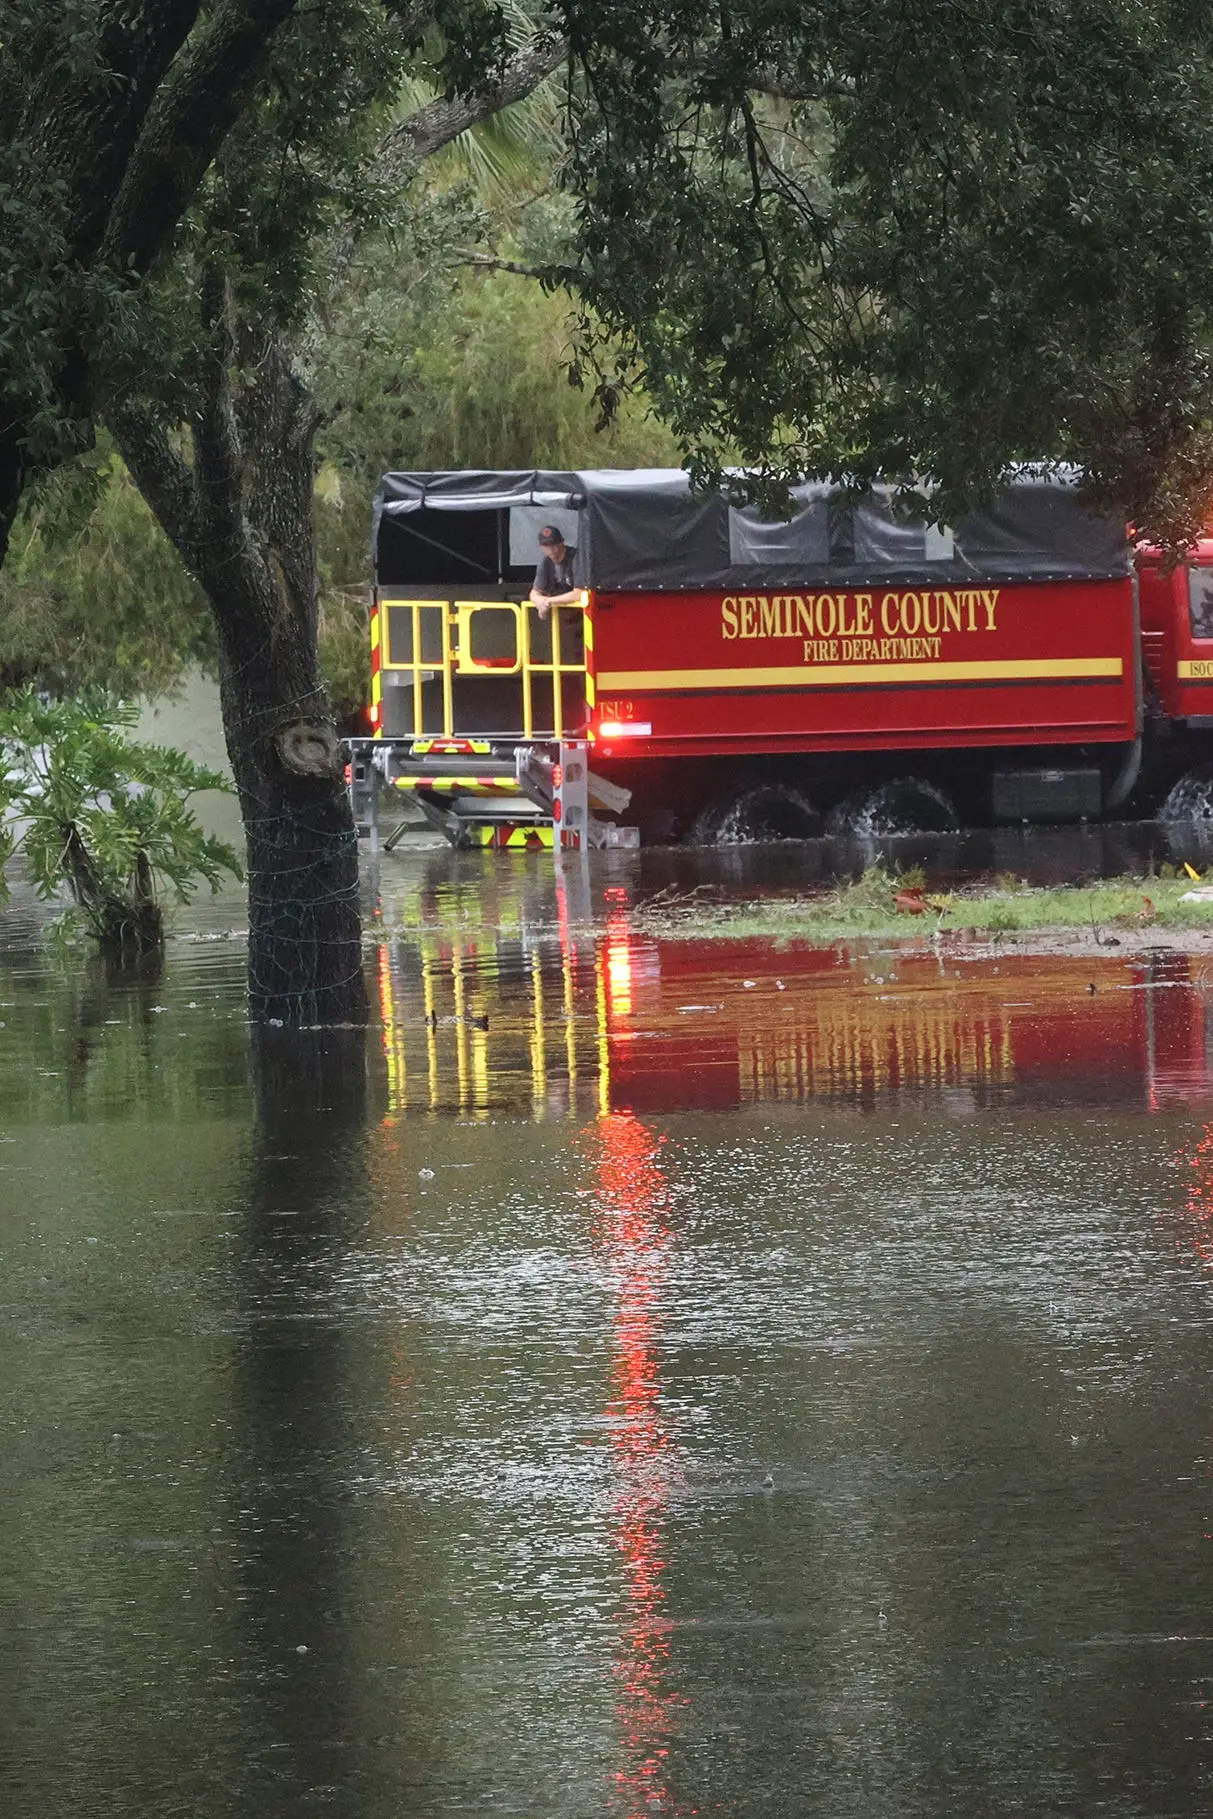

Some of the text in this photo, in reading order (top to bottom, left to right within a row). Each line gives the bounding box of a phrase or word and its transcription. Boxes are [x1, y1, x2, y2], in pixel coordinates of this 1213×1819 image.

[721, 589, 1000, 639] SEMINOLE COUNTY
[803, 636, 942, 662] FIRE DEPARTMENT
[599, 700, 633, 720] TSU 2
